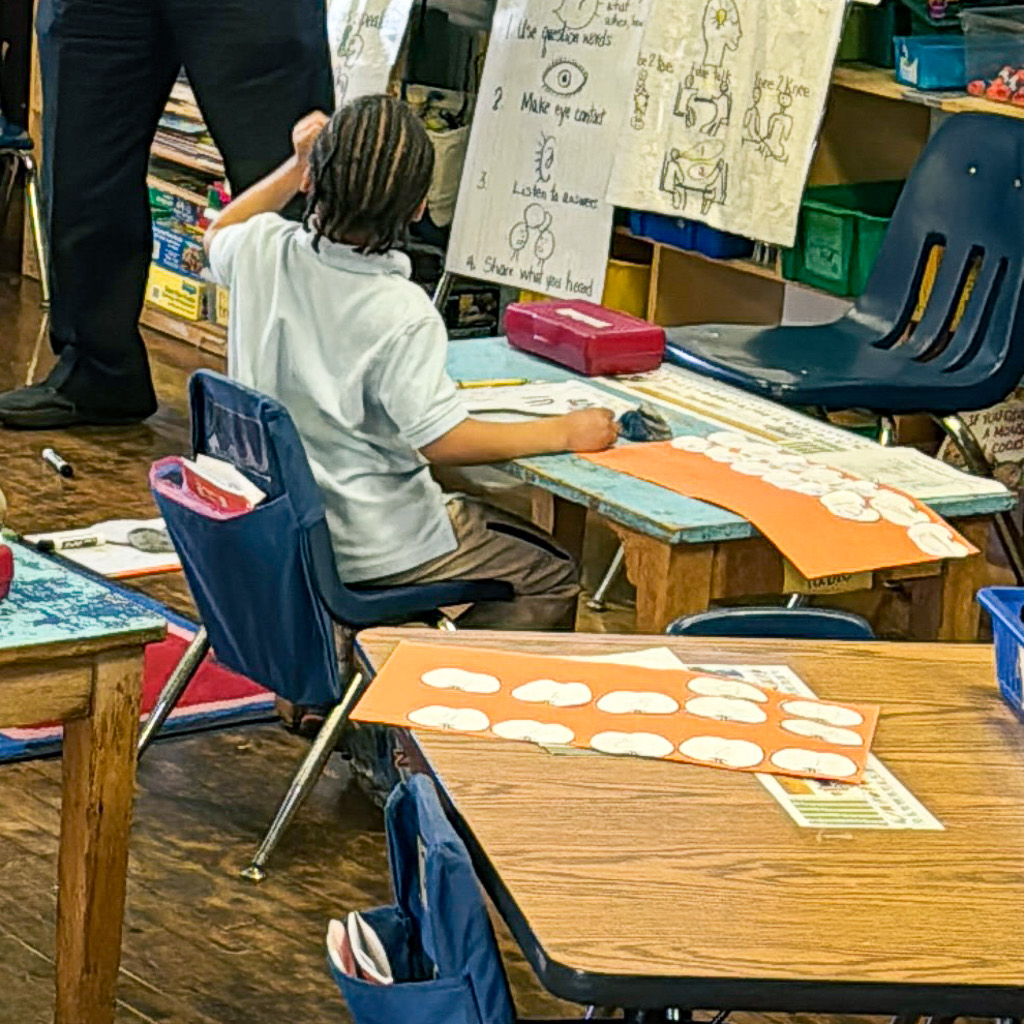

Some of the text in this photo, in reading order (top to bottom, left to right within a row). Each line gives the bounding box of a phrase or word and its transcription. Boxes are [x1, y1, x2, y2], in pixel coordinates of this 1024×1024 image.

[520, 91, 552, 115] Make
[554, 104, 571, 127] eye
[483, 255, 514, 277] Share
